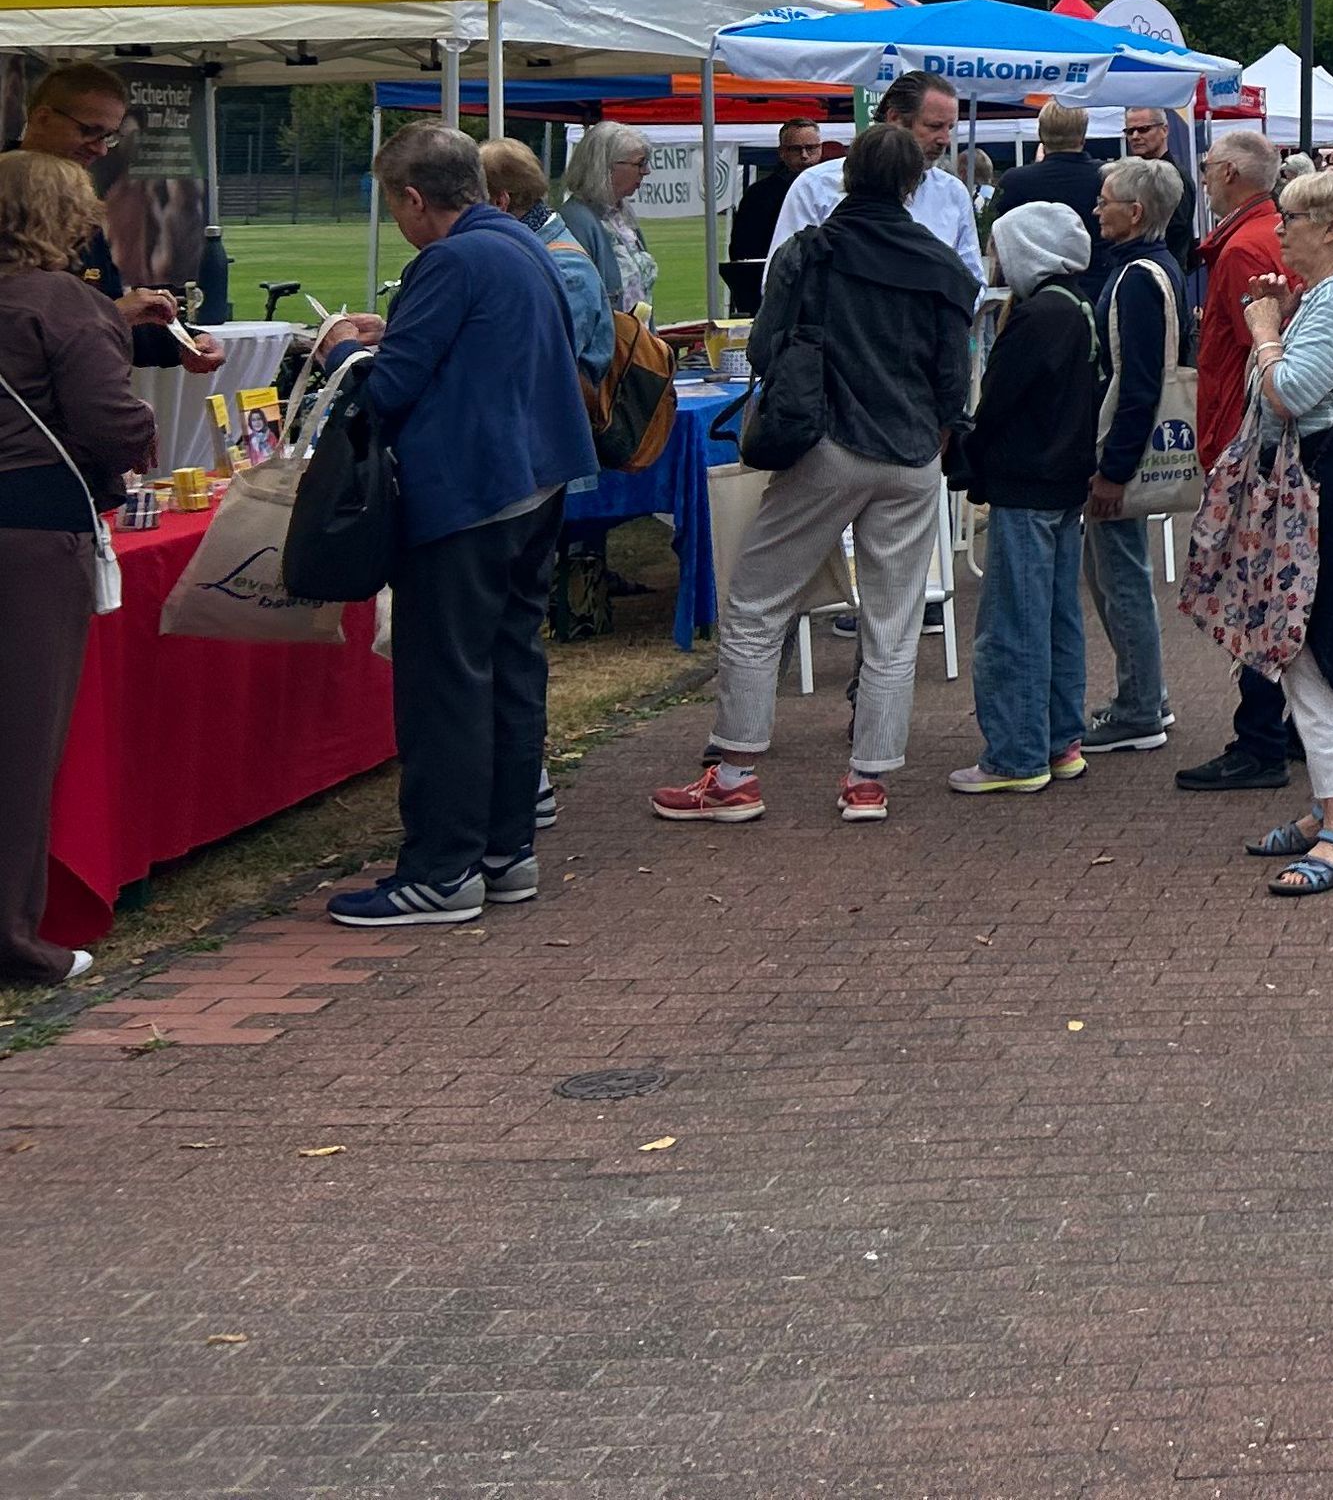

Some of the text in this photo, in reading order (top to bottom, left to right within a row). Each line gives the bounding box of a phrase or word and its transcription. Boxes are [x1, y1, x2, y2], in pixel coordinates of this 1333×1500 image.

[923, 54, 1061, 81] Diakonie
[131, 81, 191, 106] Sicherheit
[163, 107, 190, 128] Alter
[1141, 466, 1199, 483] bewegt
